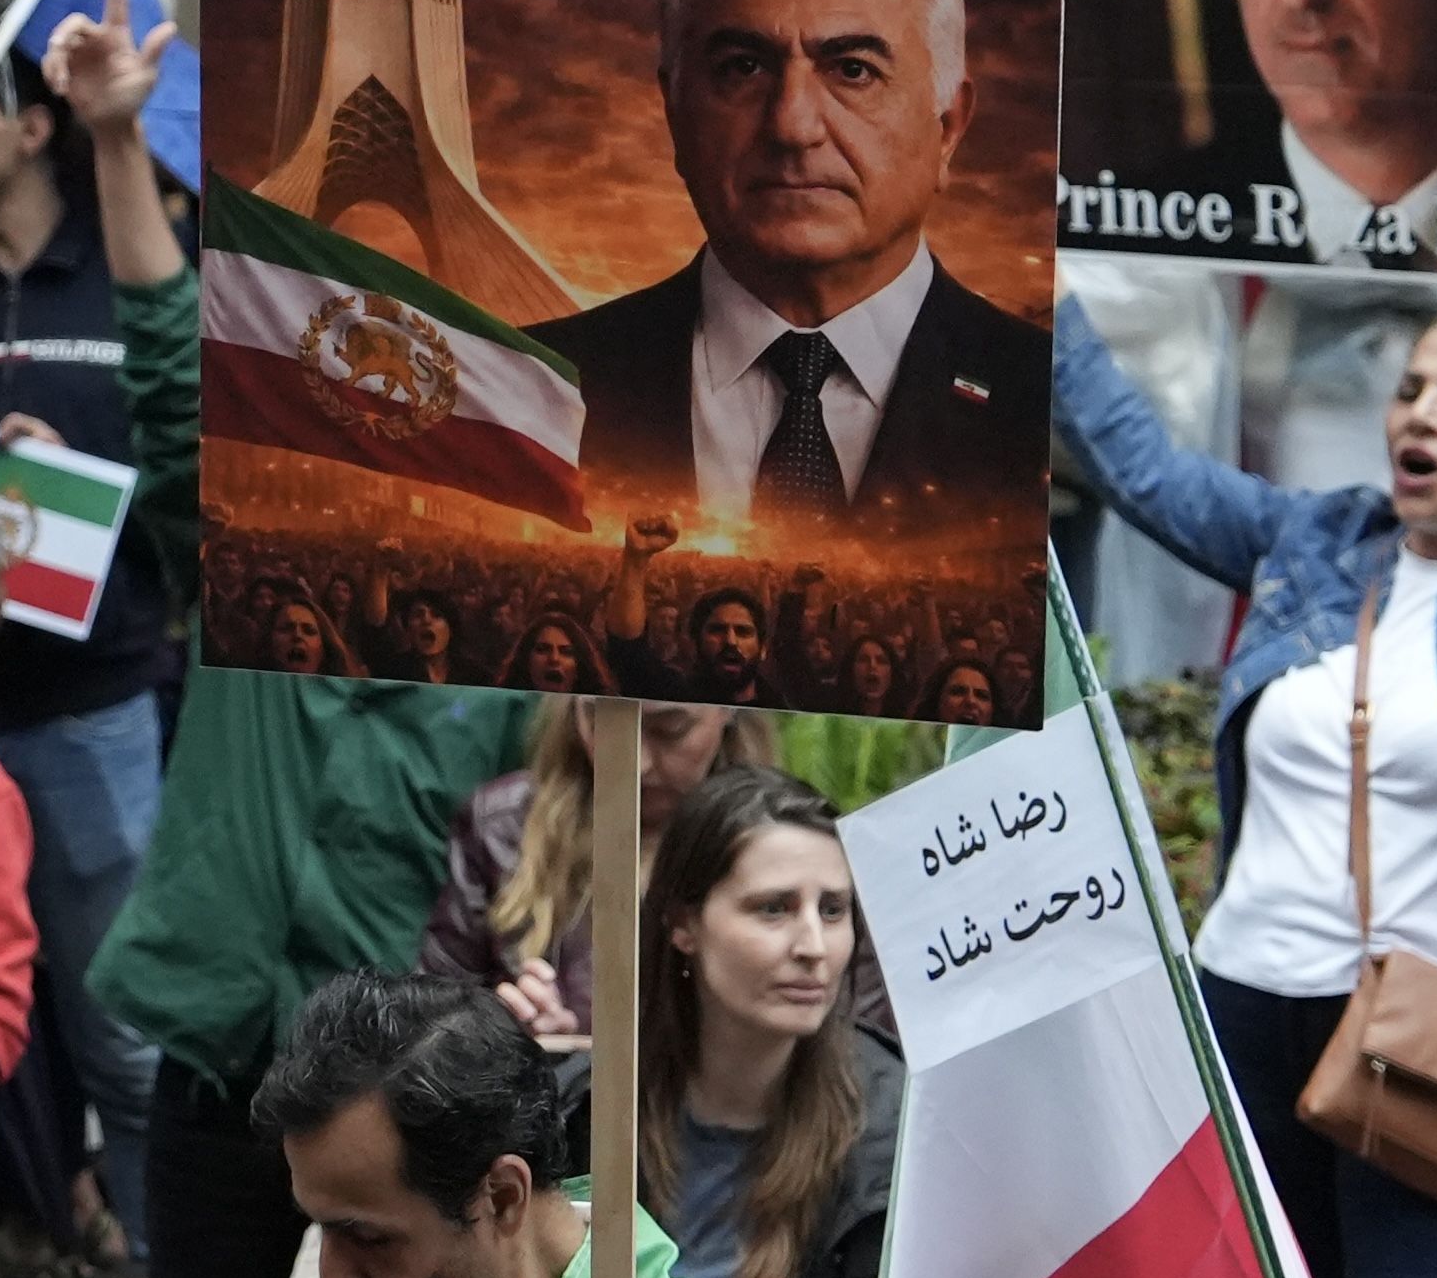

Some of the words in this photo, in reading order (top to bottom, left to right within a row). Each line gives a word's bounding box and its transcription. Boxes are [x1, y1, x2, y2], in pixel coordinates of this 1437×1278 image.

[1056, 168, 1232, 243] rince
[1248, 183, 1417, 256] Rza
[922, 814, 987, 877] شاه
[990, 790, 1068, 841] رضا
[1003, 867, 1125, 942] روحت
[927, 915, 993, 981] شاد
